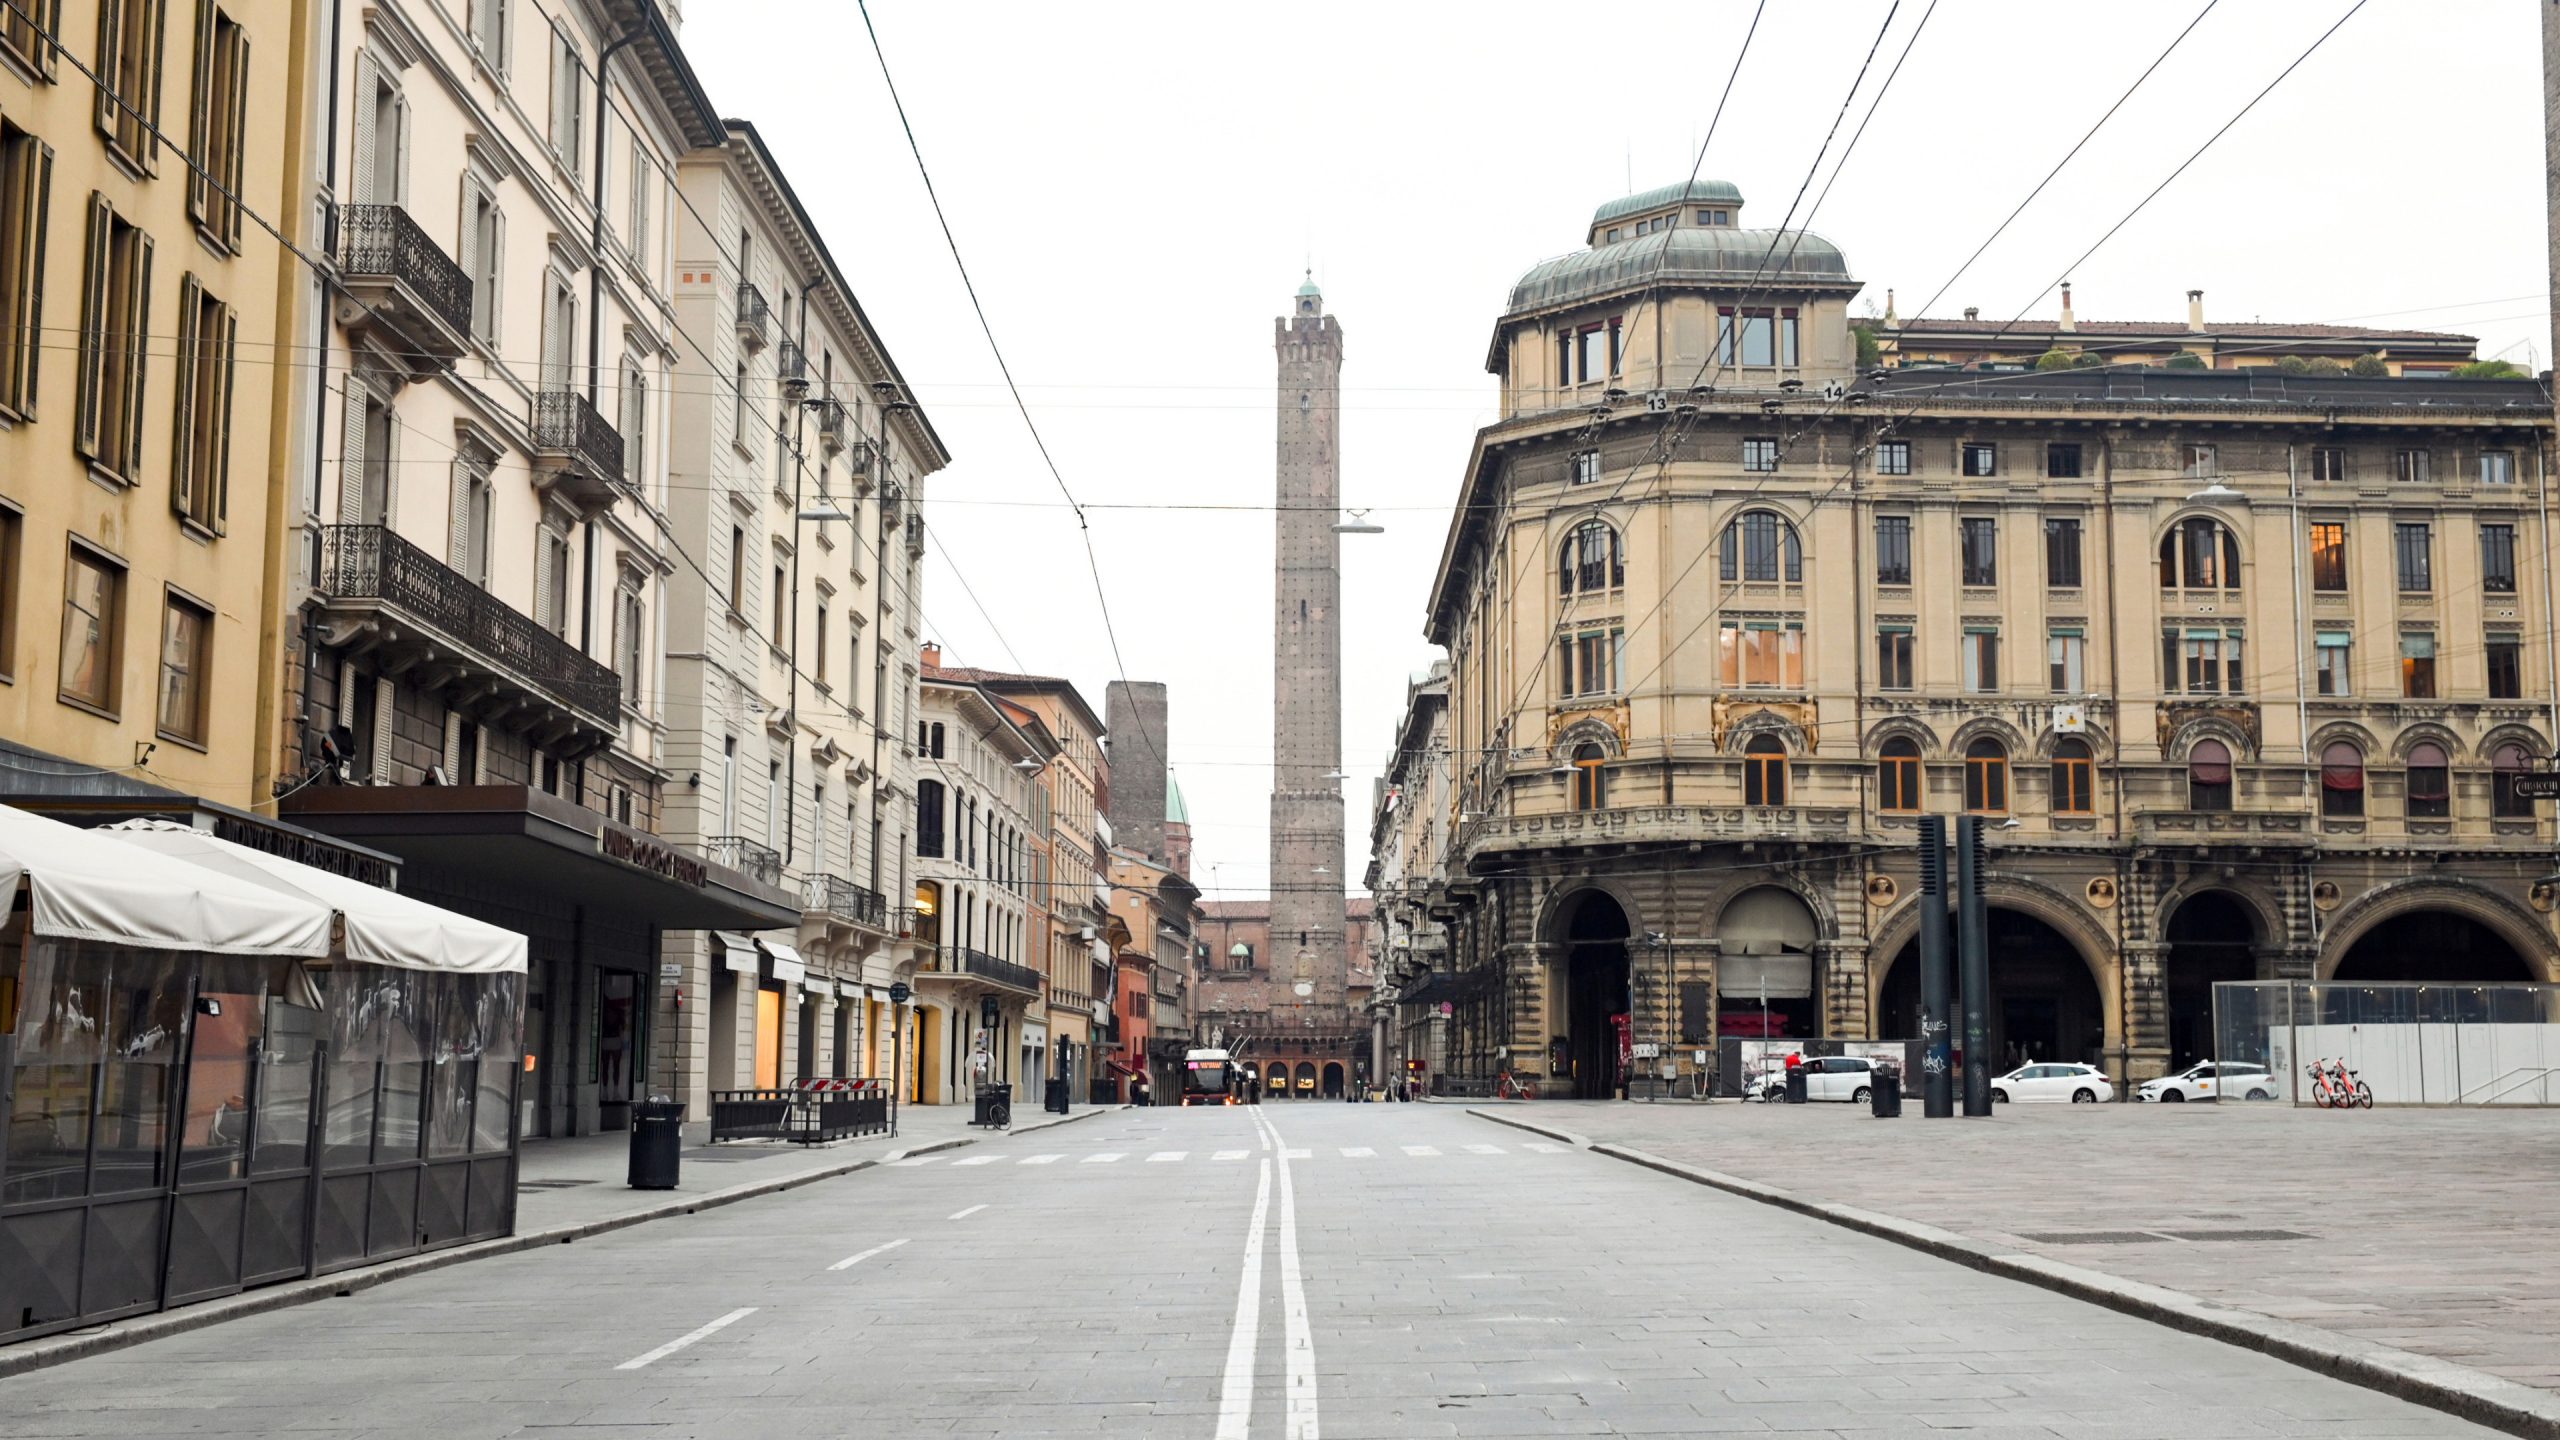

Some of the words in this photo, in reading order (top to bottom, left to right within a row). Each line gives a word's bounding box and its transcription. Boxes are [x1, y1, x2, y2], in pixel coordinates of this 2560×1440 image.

[1825, 386, 1843, 399] 14
[1648, 398, 1667, 411] 13
[303, 840, 345, 875] PASCHI
